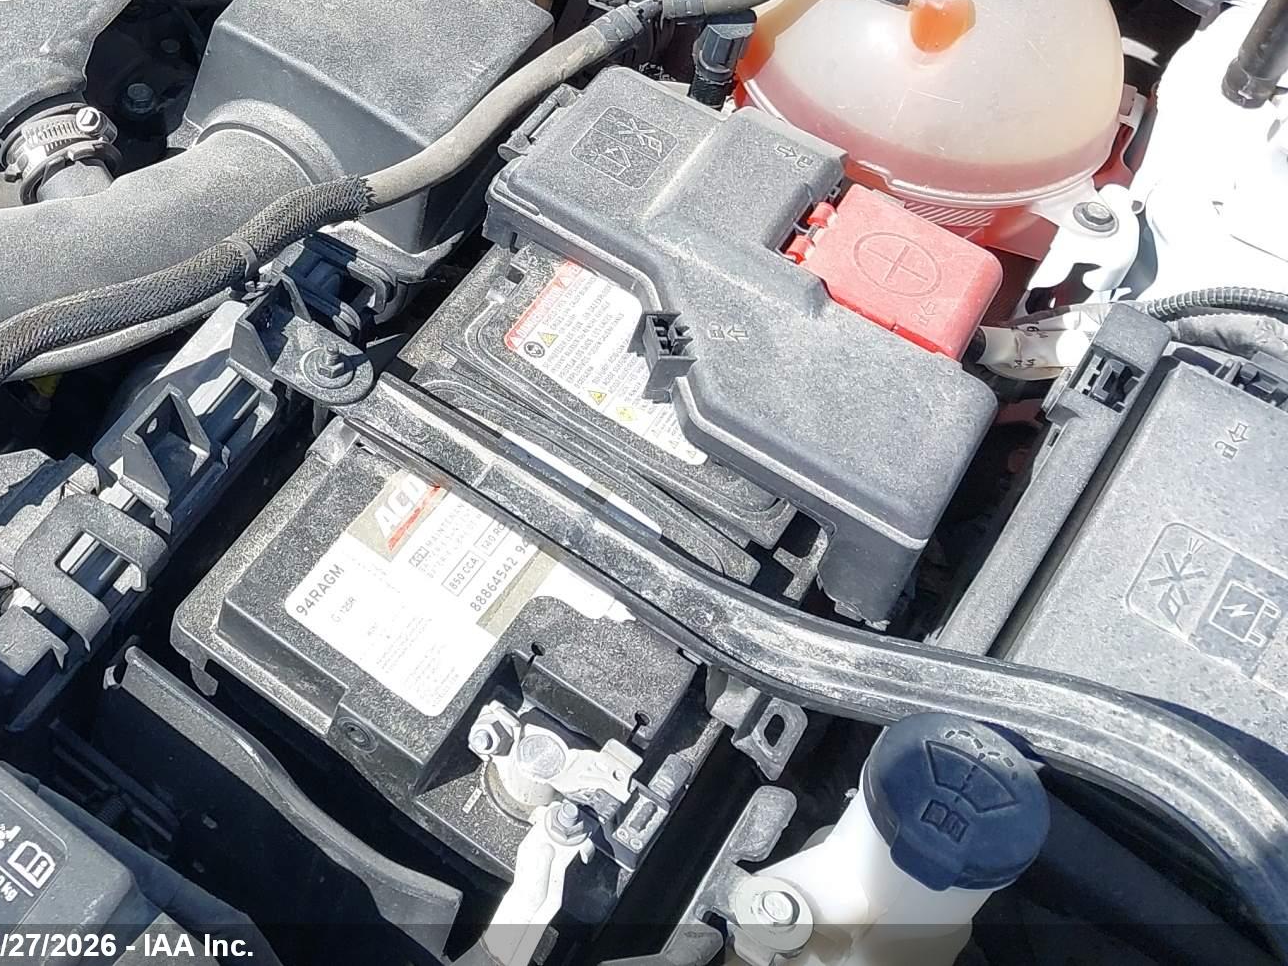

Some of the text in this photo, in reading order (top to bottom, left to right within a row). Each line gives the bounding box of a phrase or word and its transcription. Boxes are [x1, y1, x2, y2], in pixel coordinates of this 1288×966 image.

[296, 563, 345, 617] 94RAGM
[448, 554, 480, 591] 850 CCA
[470, 556, 519, 612] 88864542
